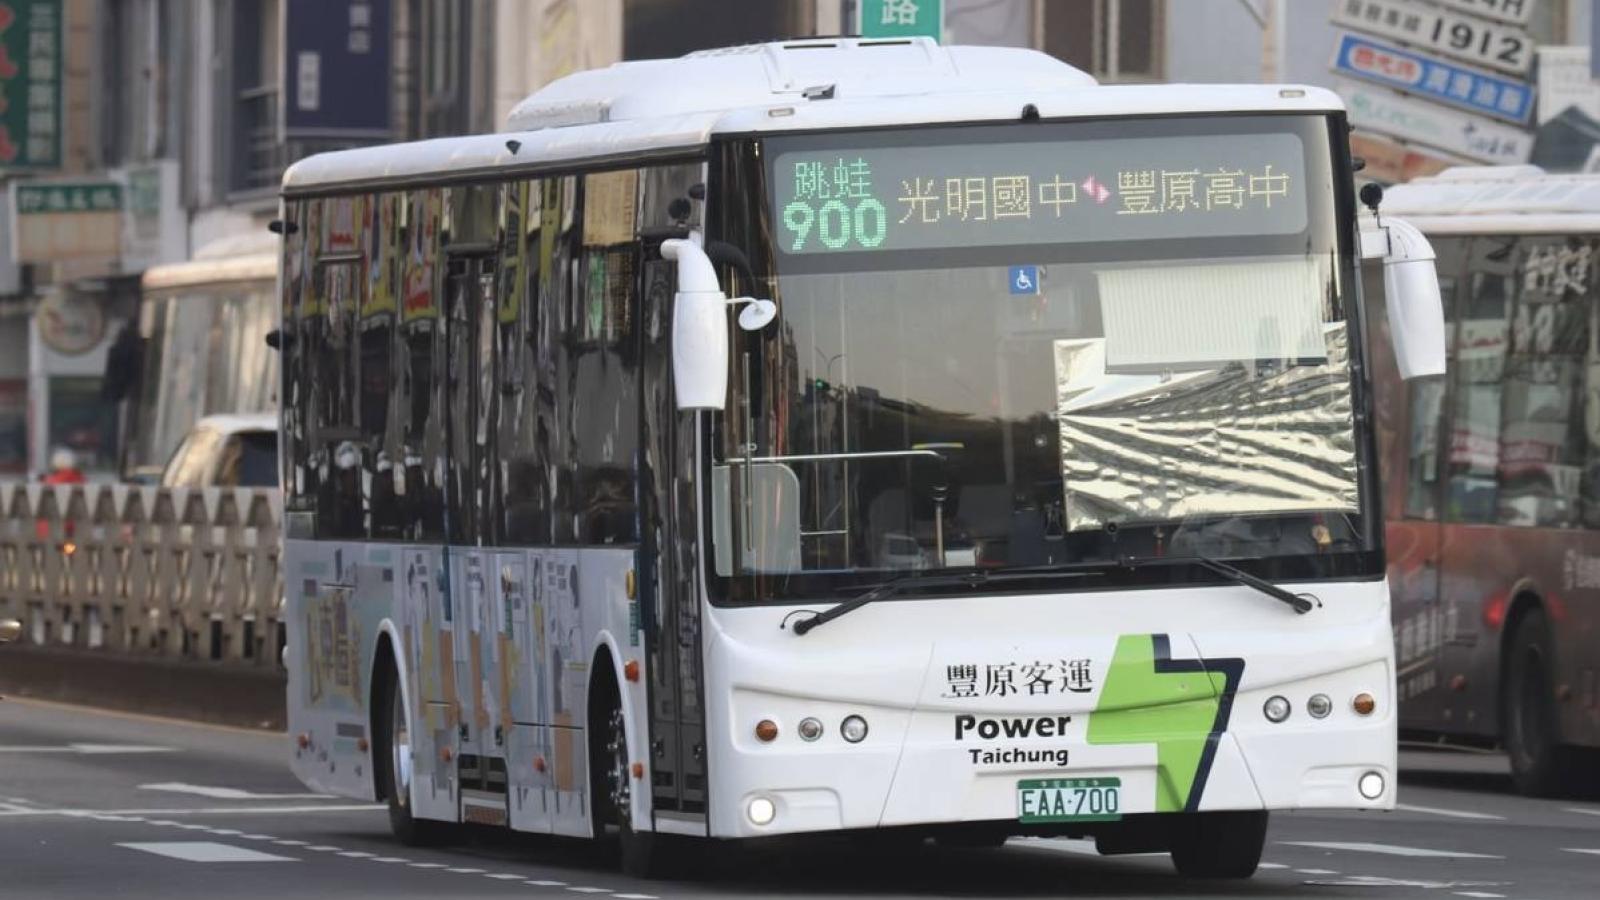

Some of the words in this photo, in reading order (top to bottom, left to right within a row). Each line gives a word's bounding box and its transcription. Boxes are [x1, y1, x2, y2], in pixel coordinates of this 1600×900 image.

[1431, 18, 1522, 64] 1912
[794, 157, 871, 199] 跳蛙
[898, 174, 1076, 223] 光明國中
[1116, 165, 1290, 214] 豐原高中
[784, 199, 886, 250] 900
[941, 659, 1093, 698] 豐原客運
[955, 715, 1071, 740] Power
[968, 748, 1069, 766] Taichung
